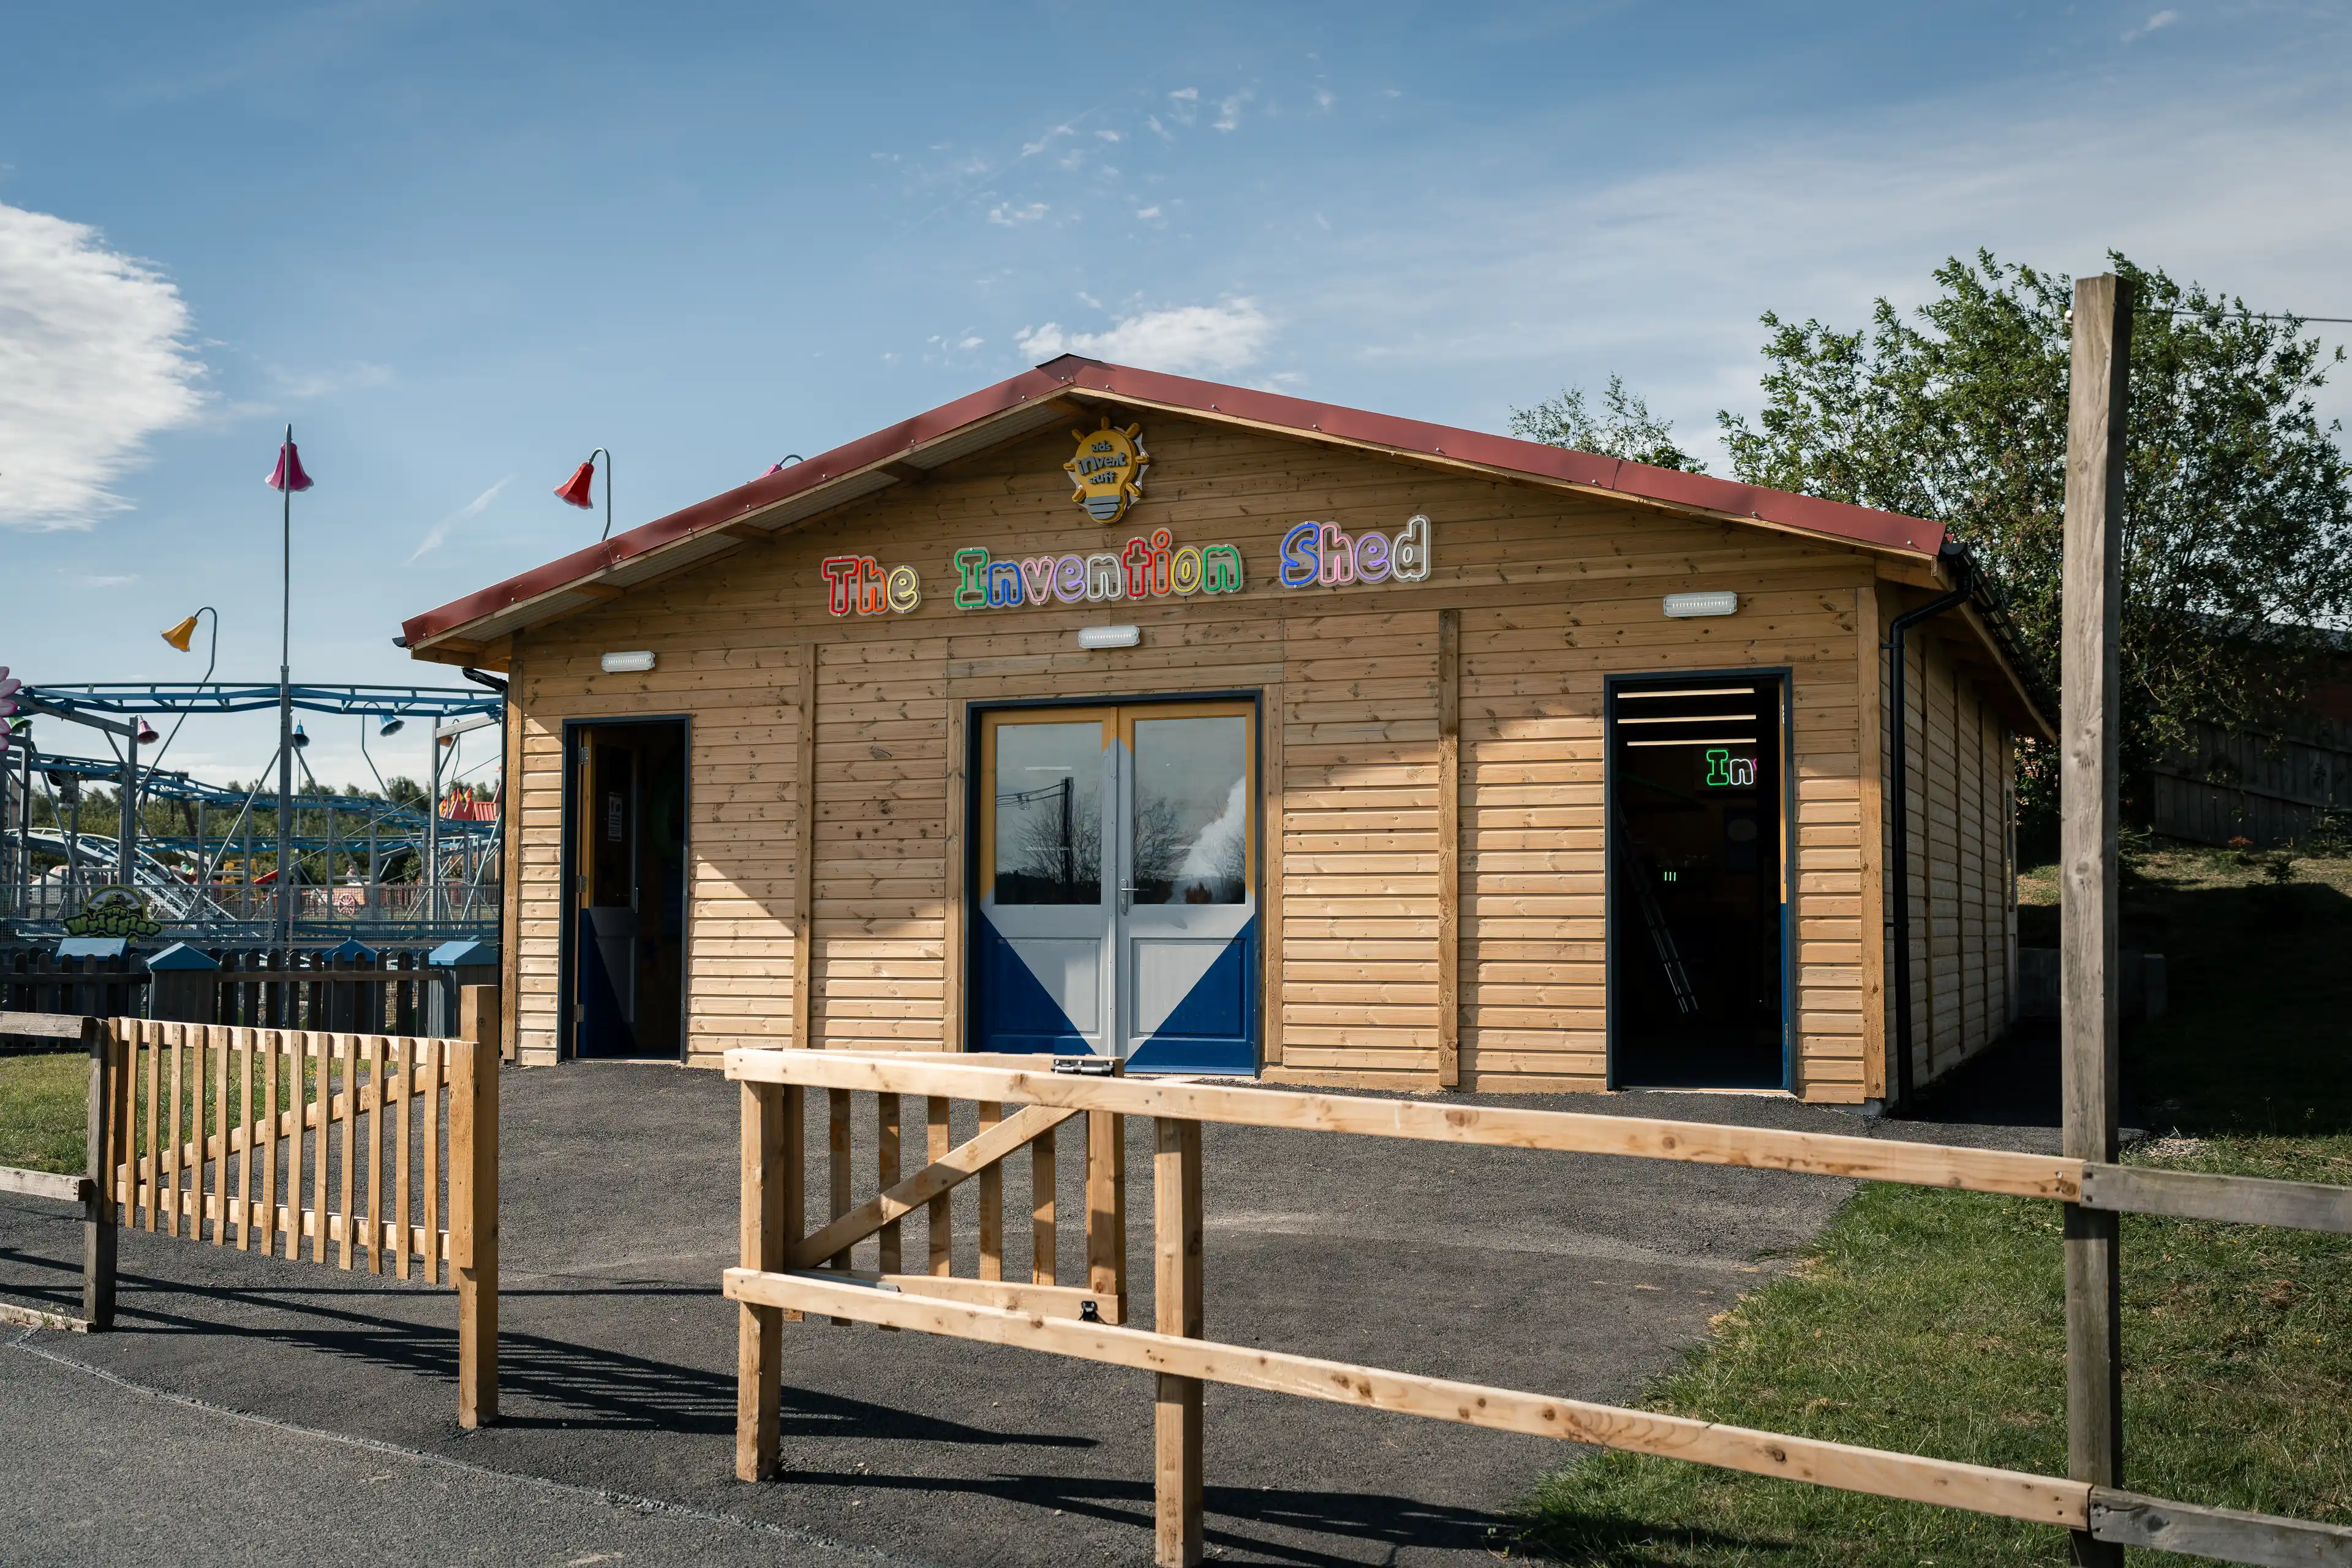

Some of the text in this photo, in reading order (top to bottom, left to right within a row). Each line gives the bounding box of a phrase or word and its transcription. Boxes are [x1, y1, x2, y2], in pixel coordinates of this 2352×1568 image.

[1091, 440, 1111, 451] kids
[1076, 451, 1126, 475] invent
[1088, 470, 1115, 483] stuff
[822, 517, 1428, 614] The Invention Shed
[66, 915, 160, 935] Wriggler
